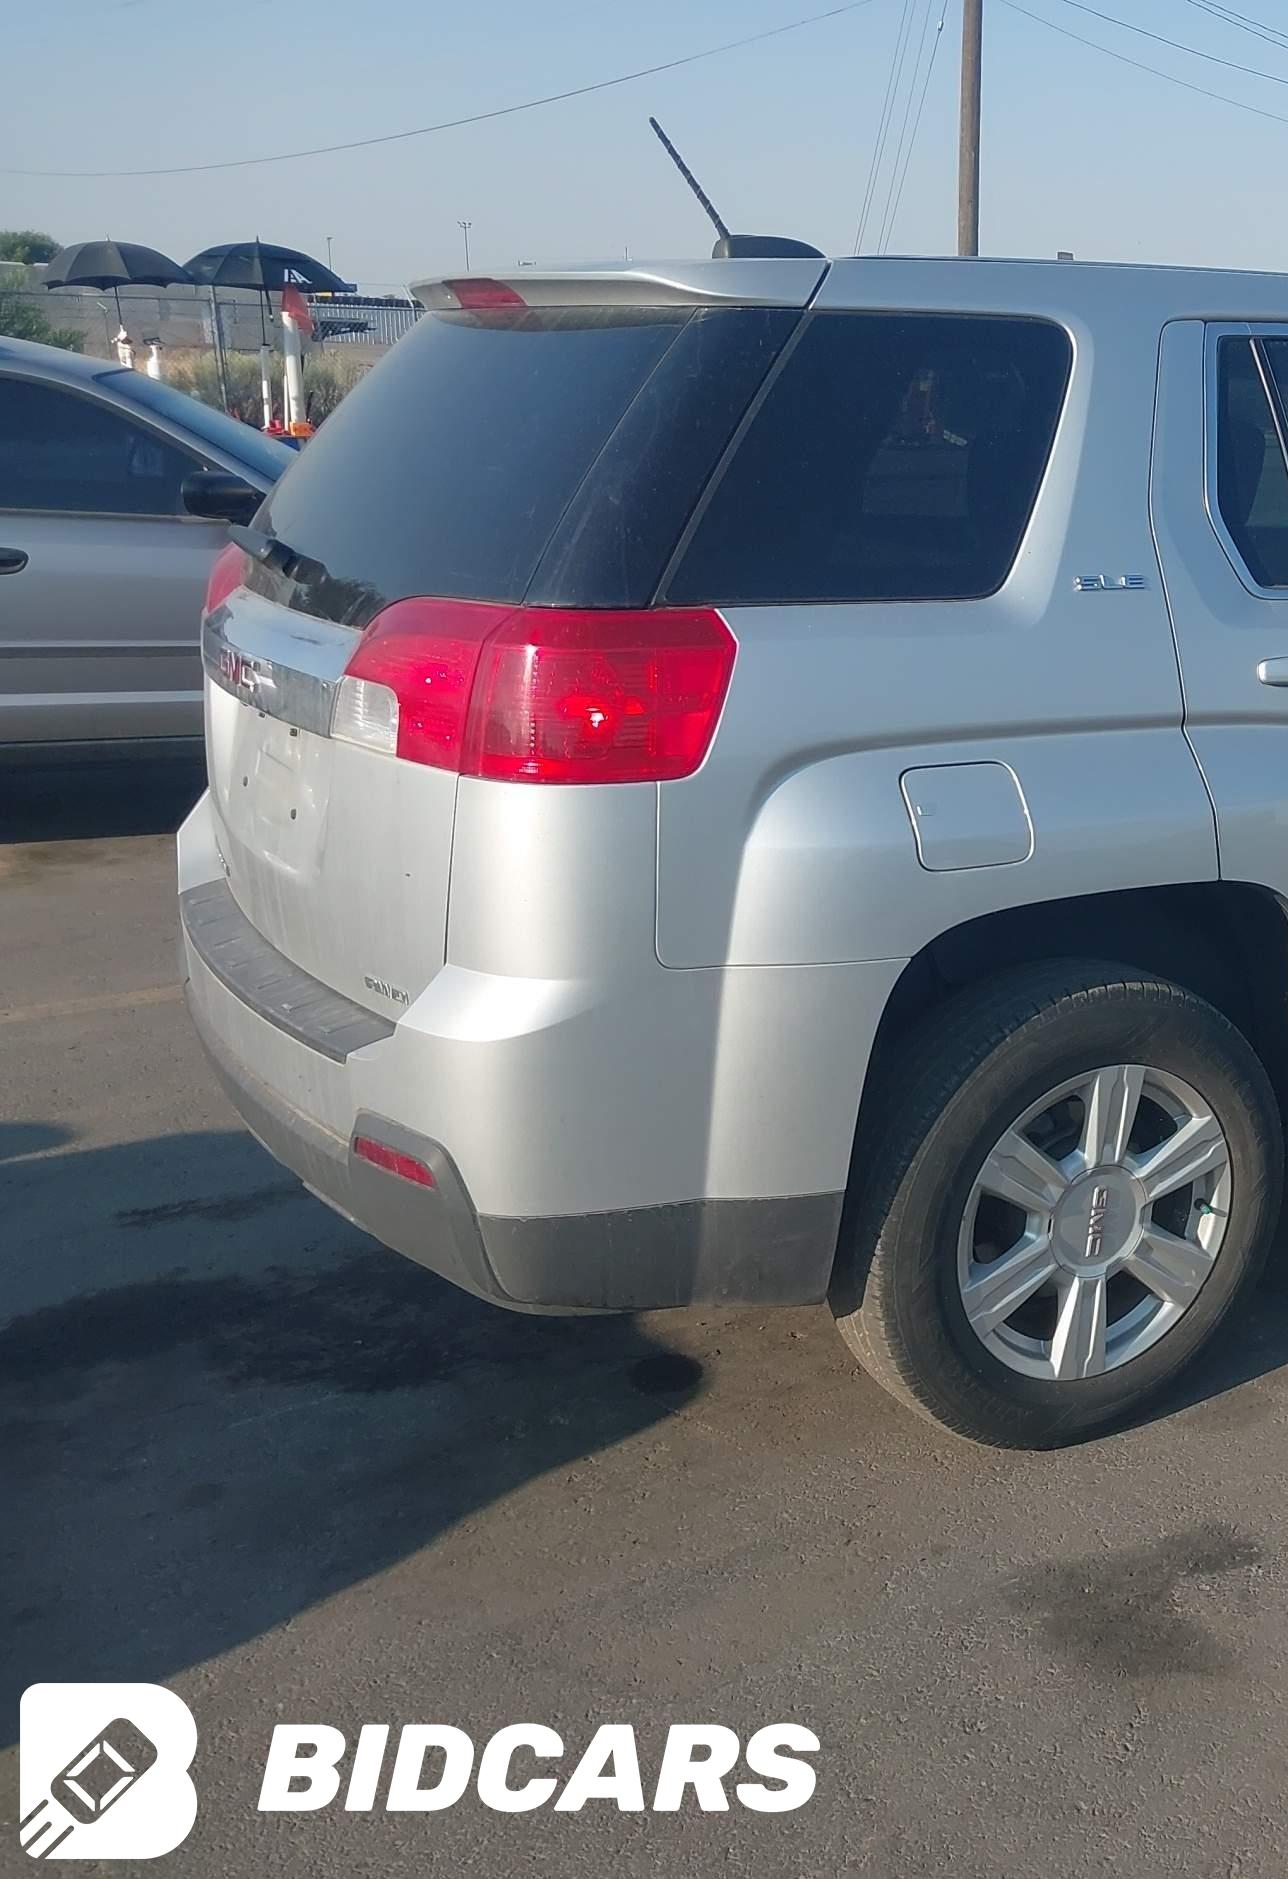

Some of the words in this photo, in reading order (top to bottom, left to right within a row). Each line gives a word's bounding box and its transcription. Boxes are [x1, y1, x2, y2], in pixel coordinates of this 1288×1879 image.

[1073, 573, 1148, 592] SLE
[220, 649, 261, 693] GMC
[1085, 1185, 1107, 1258] GMC
